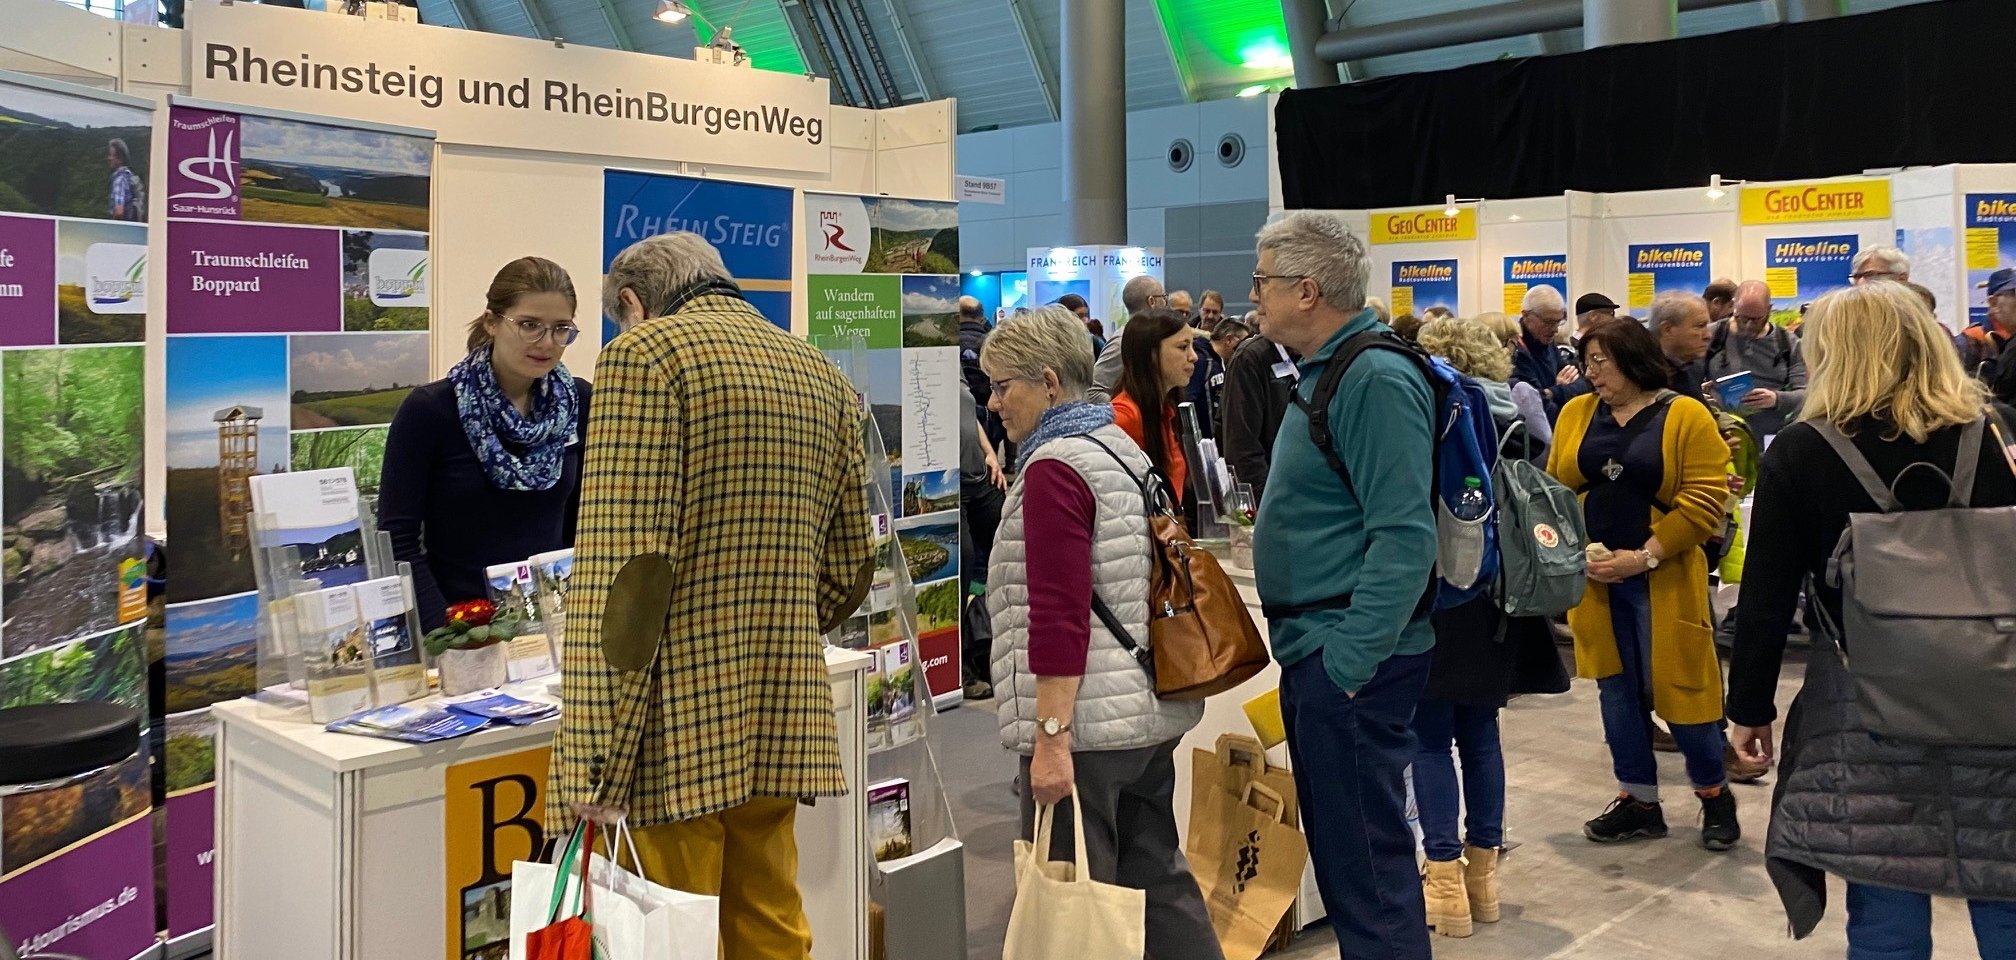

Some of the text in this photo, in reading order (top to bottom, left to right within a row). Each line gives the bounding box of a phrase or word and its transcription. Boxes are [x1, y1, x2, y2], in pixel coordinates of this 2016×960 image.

[205, 43, 824, 145] Rheinsteig und RheinBurgenWeg
[173, 114, 236, 131] Traumschleifen
[964, 180, 982, 189] Stand
[1765, 187, 1864, 214] GEOCENTER
[172, 203, 237, 216] Saar-Hunsrück
[1387, 213, 1458, 235] GEOCENTER
[1637, 247, 1703, 264] bikeline
[1775, 241, 1851, 257] Hikeline
[191, 250, 309, 270] Traumschleifen
[814, 253, 863, 265] RheinBurgenWeg
[1030, 255, 1097, 268] FRANEICH
[1103, 255, 1162, 268] FRANEICH
[1775, 255, 1850, 263] Wanderführer
[1399, 264, 1452, 279] bikeline
[191, 276, 260, 296] Boppard
[824, 288, 875, 302] Wandern
[815, 305, 896, 322] auf sagenhaften
[832, 325, 871, 340] Wegen
